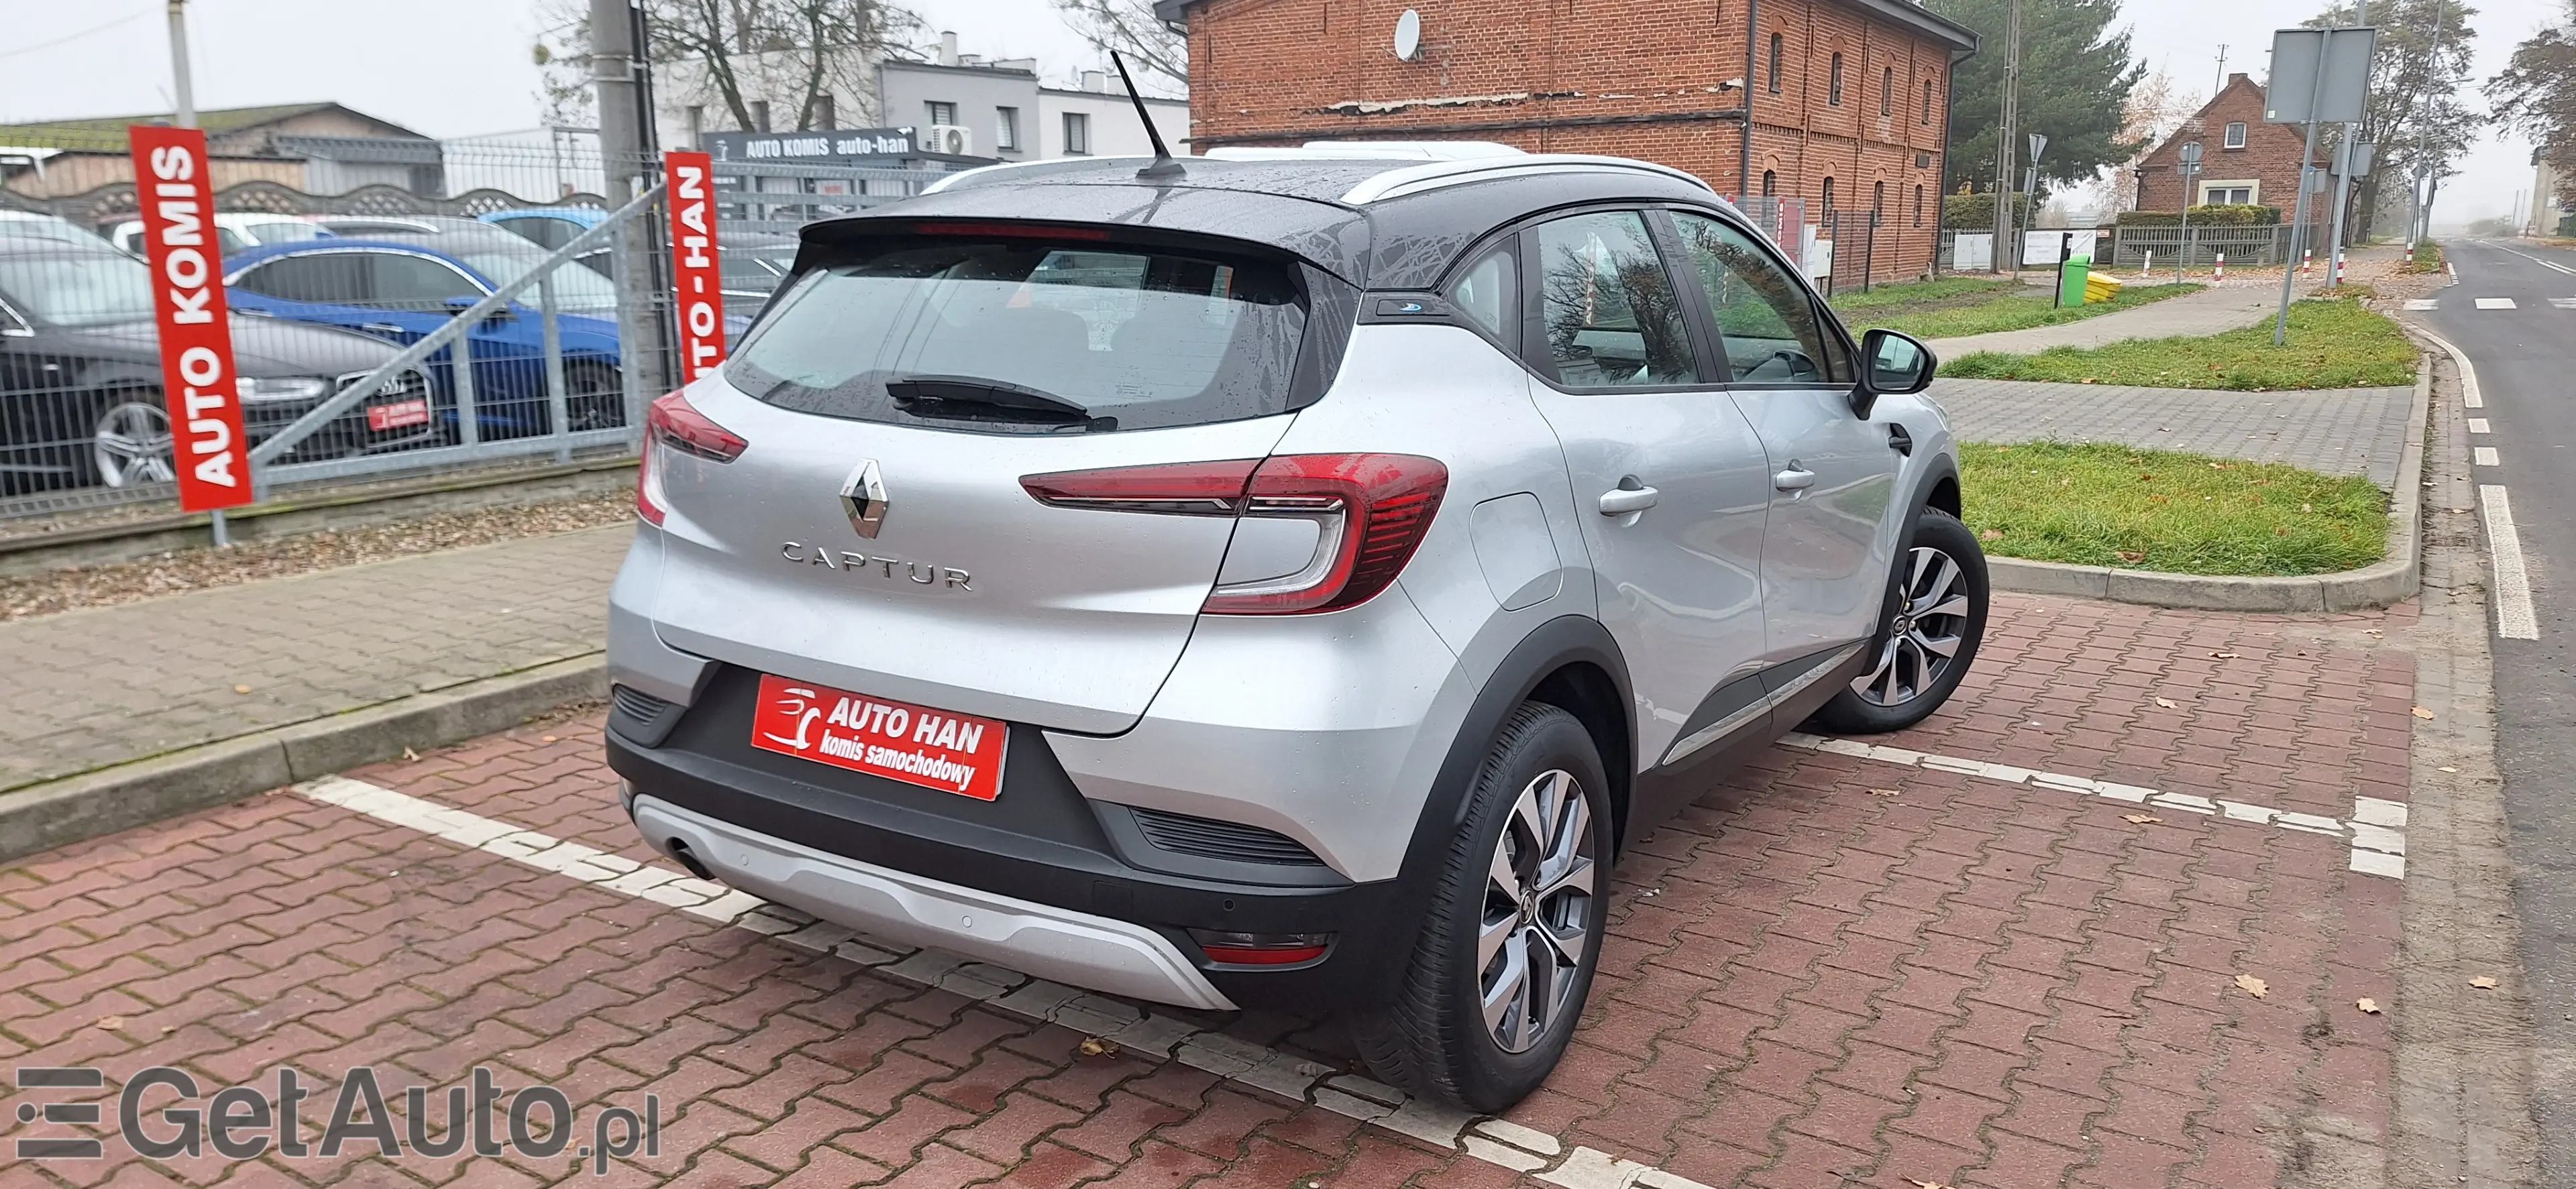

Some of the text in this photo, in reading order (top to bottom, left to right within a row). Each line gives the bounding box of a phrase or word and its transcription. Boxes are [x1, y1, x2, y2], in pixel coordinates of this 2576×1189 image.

[746, 135, 909, 158] AUTO KOMIS auto-han
[151, 145, 236, 488] AUTO KOMIS
[782, 541, 973, 591] CAPTUR
[826, 696, 985, 755] AUTO HAN
[819, 729, 977, 792] komis samochodowy
